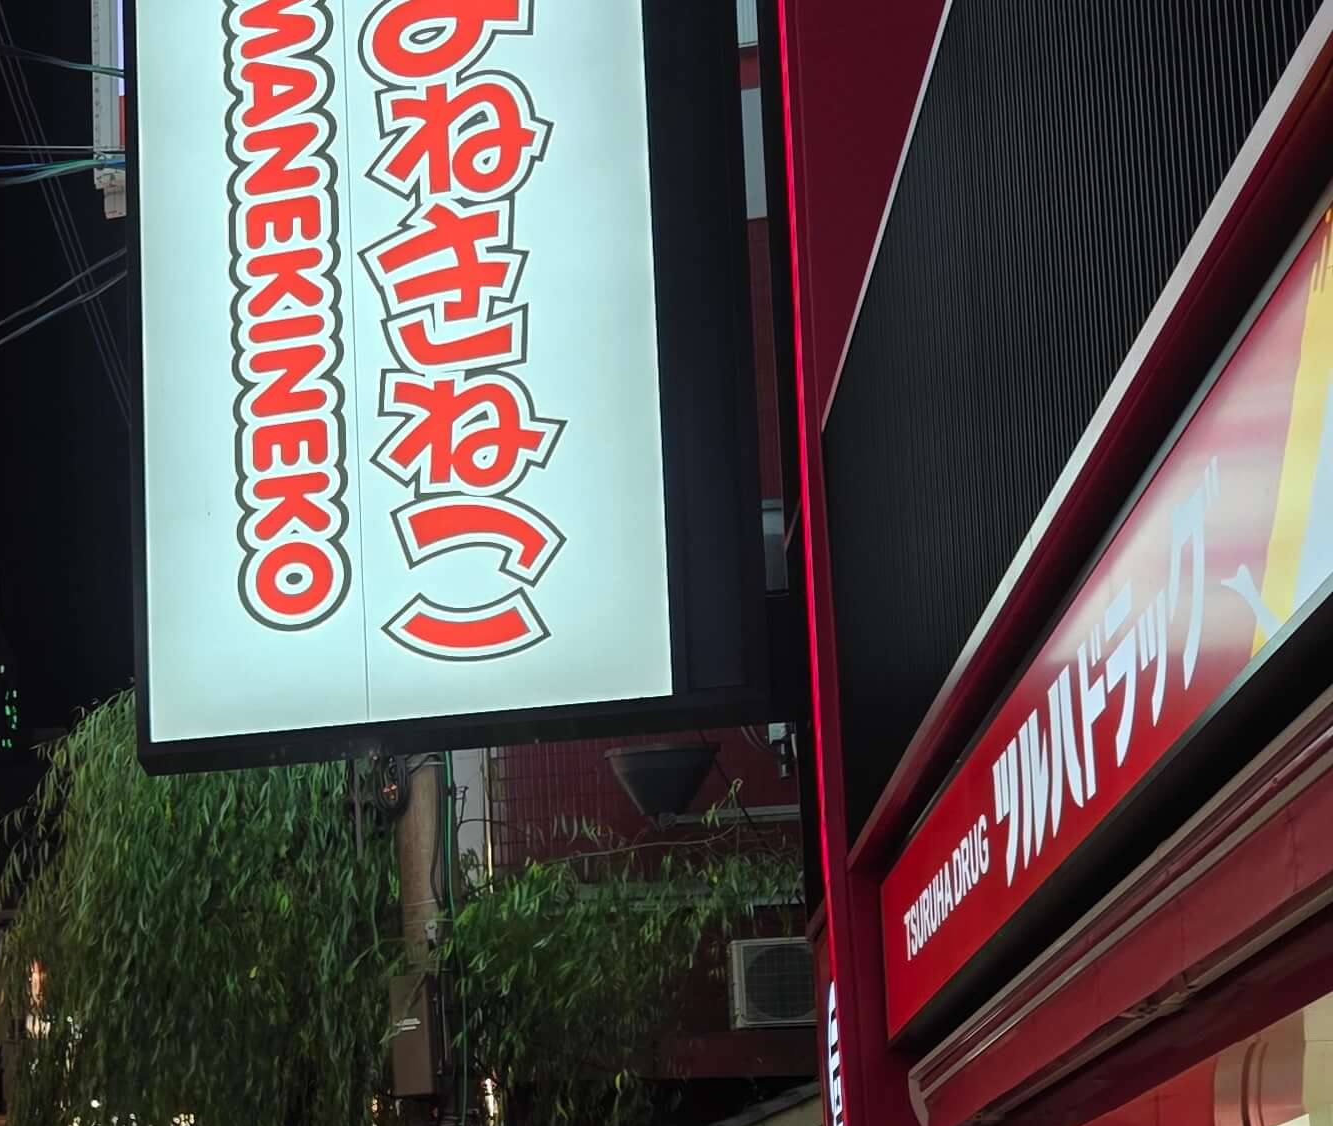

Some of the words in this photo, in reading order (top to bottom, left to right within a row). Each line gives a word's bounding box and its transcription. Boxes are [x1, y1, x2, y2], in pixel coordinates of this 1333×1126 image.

[233, 0, 341, 622] MANEKINEKO
[991, 456, 1220, 887] ツルハドラッグ
[902, 860, 955, 962] TSURUHA
[951, 813, 990, 906] DRUG
